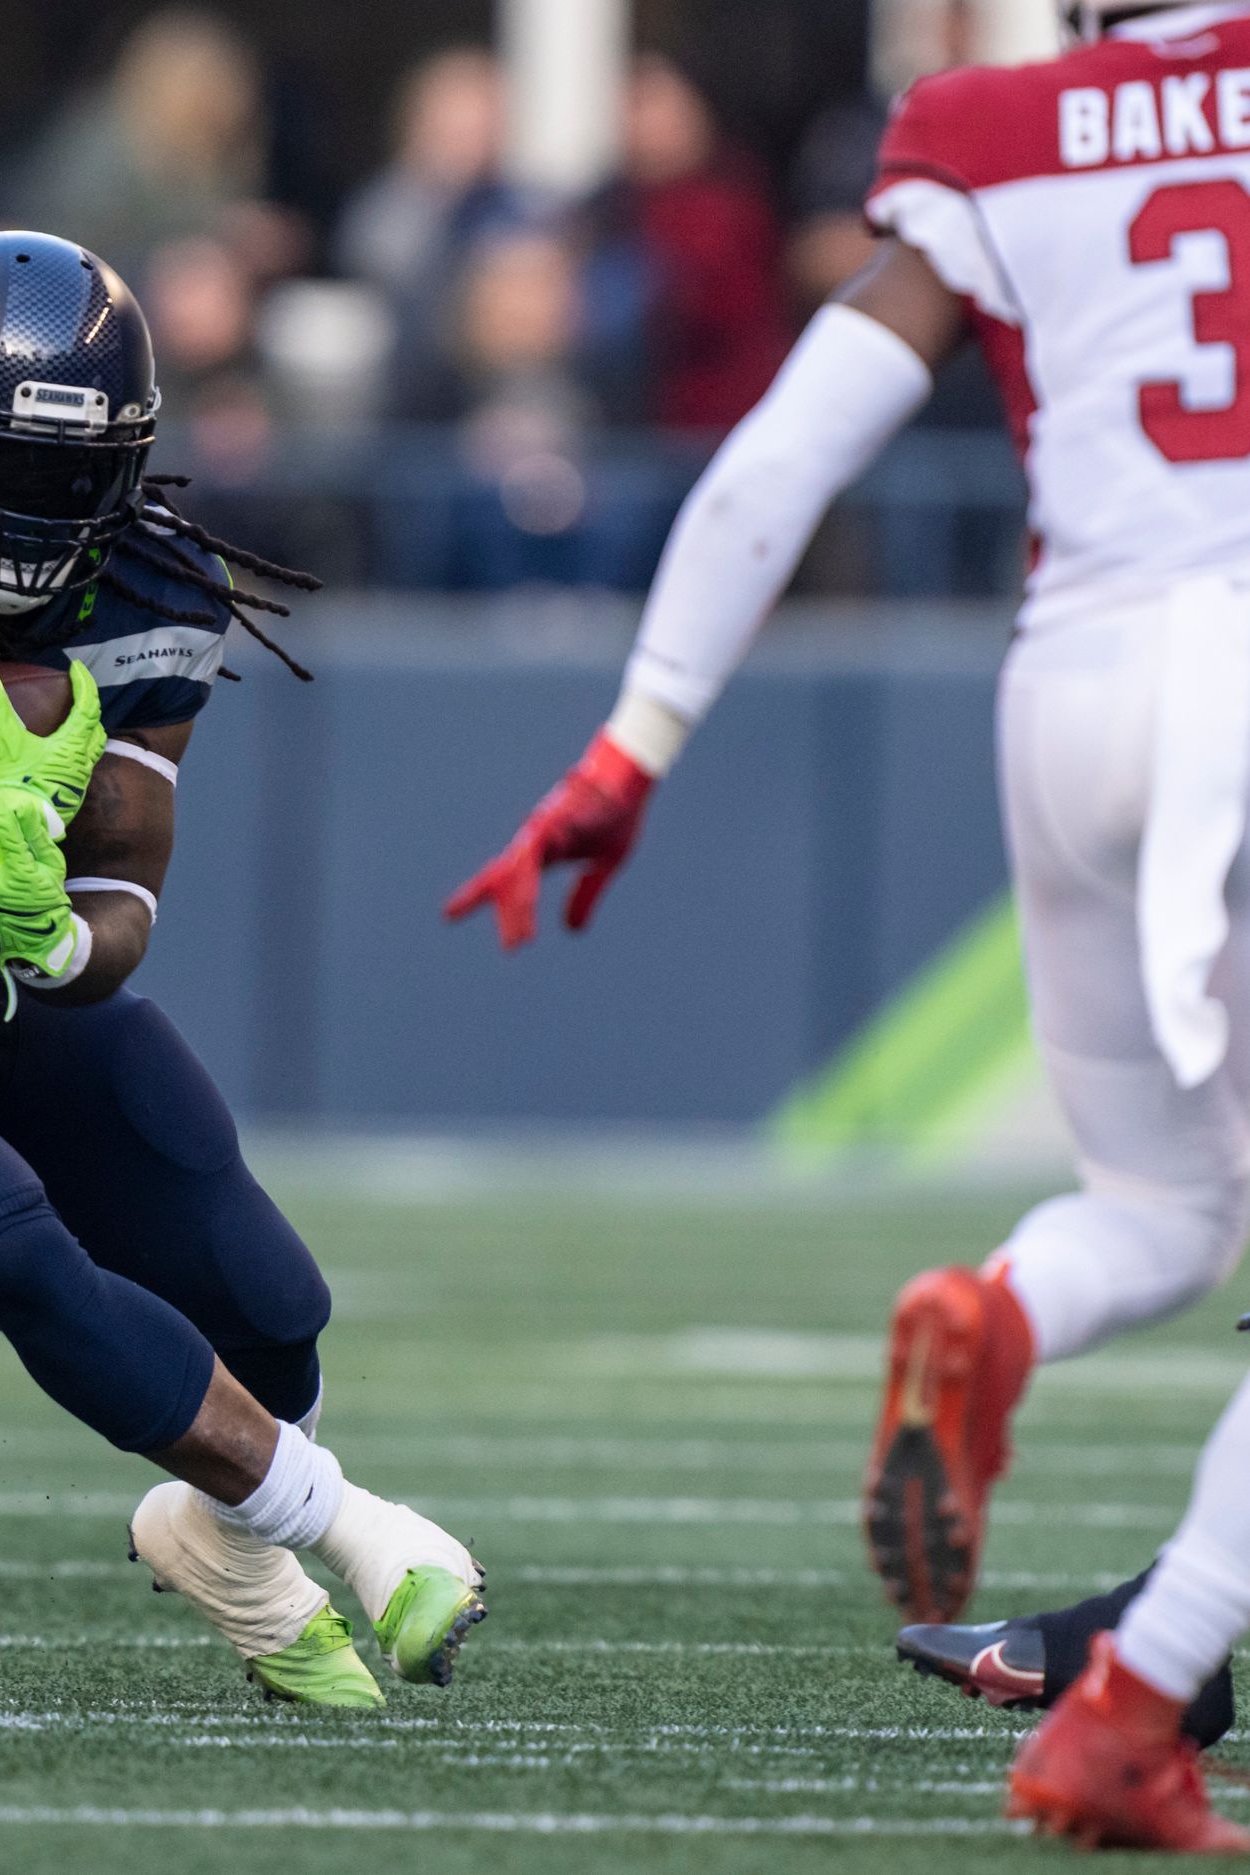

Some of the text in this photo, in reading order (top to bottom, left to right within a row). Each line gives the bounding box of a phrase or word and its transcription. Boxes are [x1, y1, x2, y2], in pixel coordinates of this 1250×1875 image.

[1058, 67, 1250, 168] BAKE
[1129, 180, 1250, 463] 3
[35, 387, 85, 407] SEAHAWKS
[114, 647, 195, 667] SEAHAWKS
